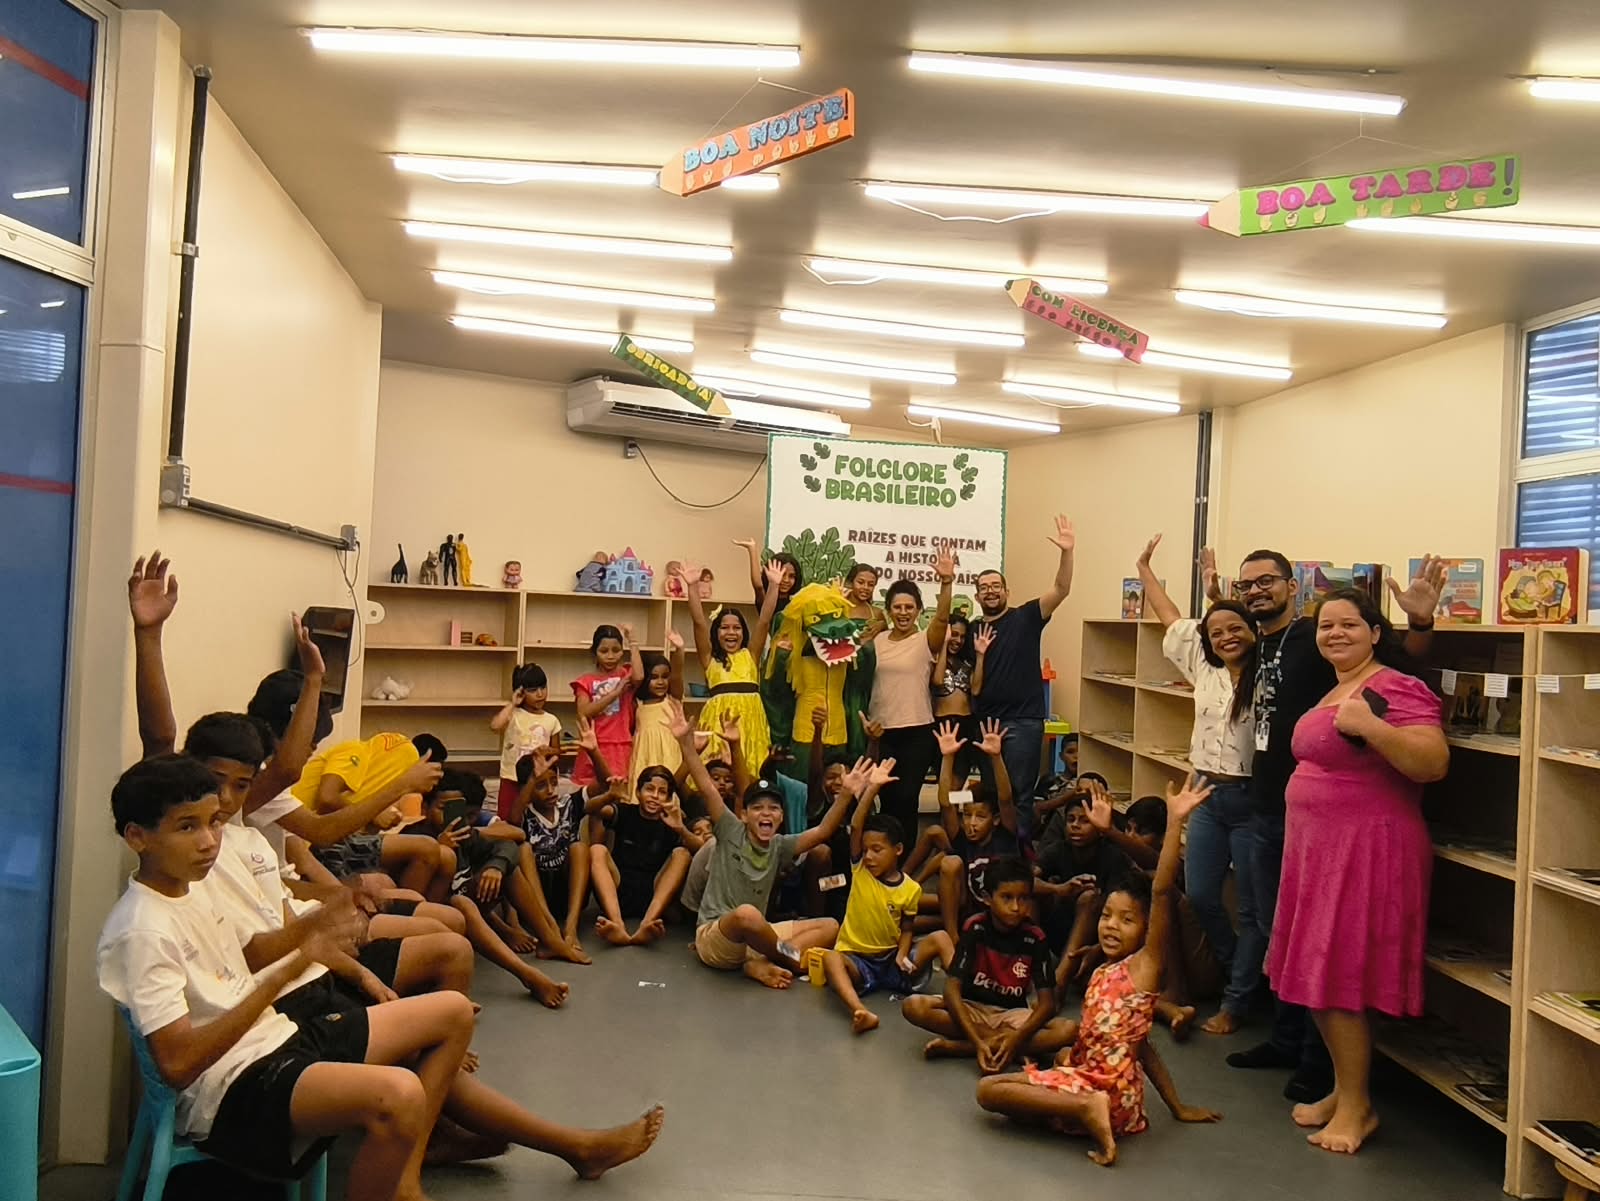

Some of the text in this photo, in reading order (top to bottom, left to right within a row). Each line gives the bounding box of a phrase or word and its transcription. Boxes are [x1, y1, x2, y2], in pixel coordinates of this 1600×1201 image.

[683, 91, 849, 173] BOA NOITE!
[1256, 157, 1516, 215] BOA TARDE!
[1032, 285, 1065, 309] COM
[834, 454, 948, 484] FOLCLORE
[825, 478, 957, 508] BRASILEIRO
[901, 534, 926, 547] QUE
[931, 536, 987, 551] CONTAM
[885, 549, 960, 567] A HISTÓA
